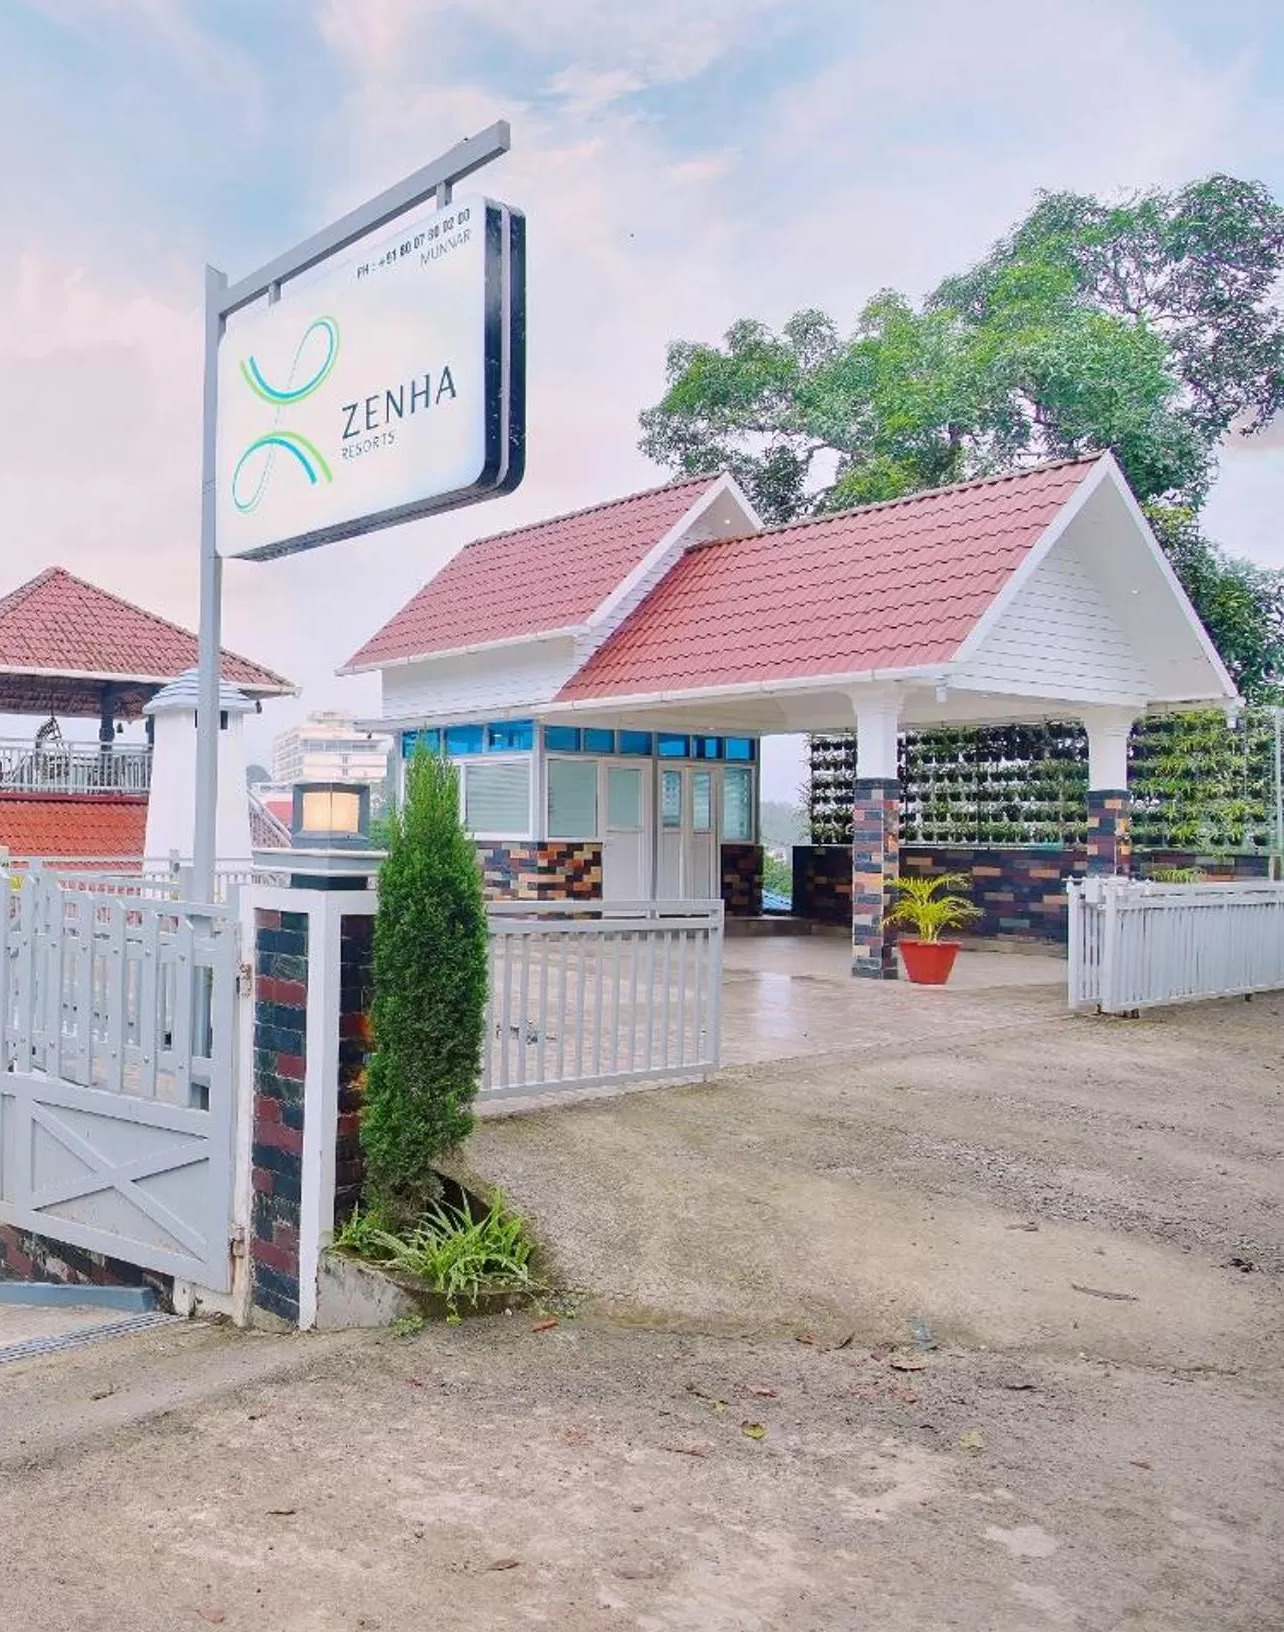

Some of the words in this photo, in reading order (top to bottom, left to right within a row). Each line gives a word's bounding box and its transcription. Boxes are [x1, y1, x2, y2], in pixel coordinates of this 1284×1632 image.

[420, 228, 471, 267] MUNNAR
[342, 366, 456, 439] ZENHA
[341, 431, 395, 459] RESORTS
